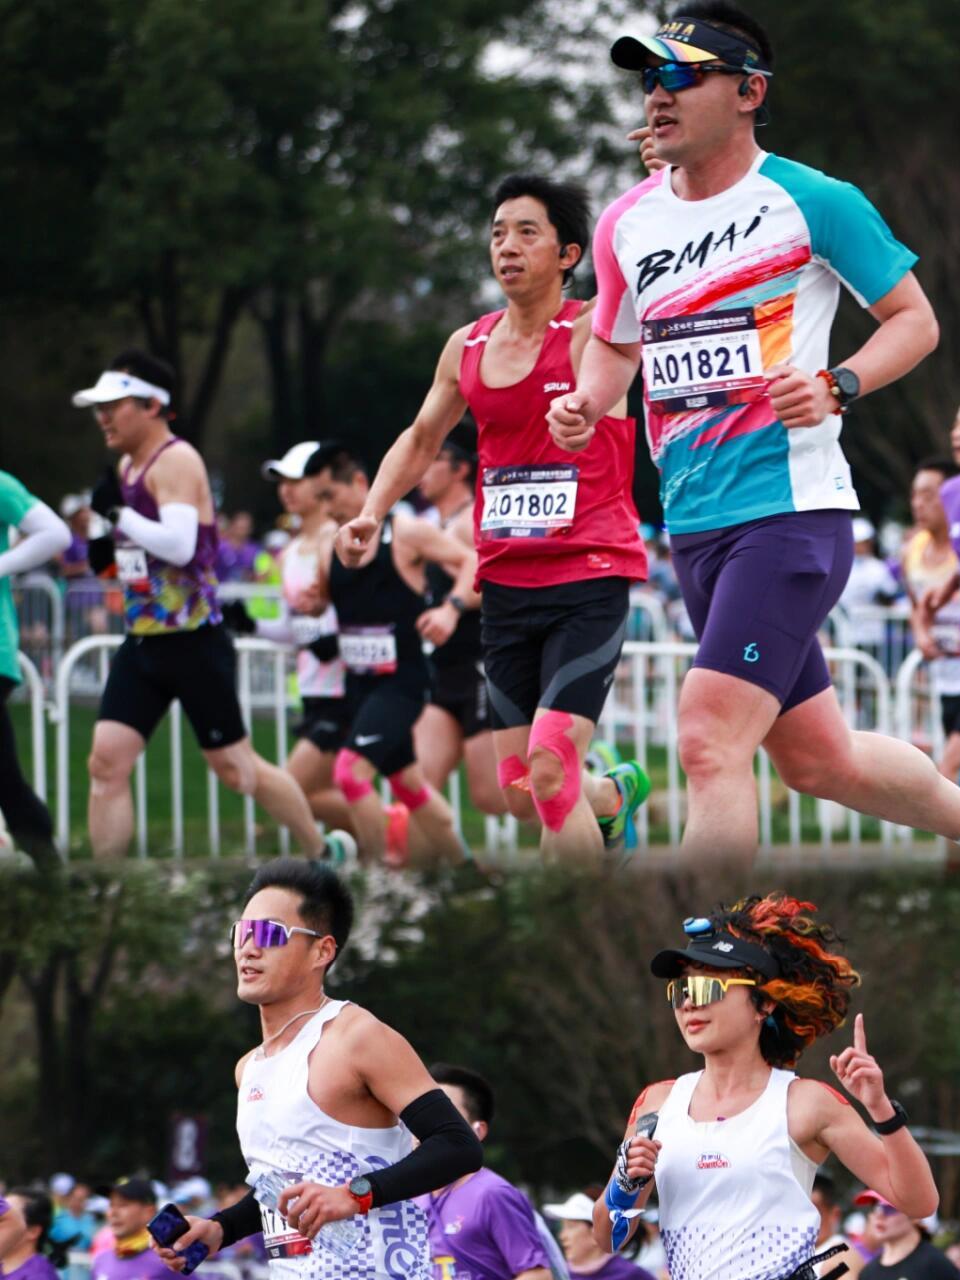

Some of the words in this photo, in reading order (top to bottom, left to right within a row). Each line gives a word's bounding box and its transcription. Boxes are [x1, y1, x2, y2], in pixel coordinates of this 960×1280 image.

[635, 215, 761, 297] BMAI
[652, 344, 750, 386] A01821
[543, 382, 571, 393] SRUN
[487, 492, 567, 518] A01802
